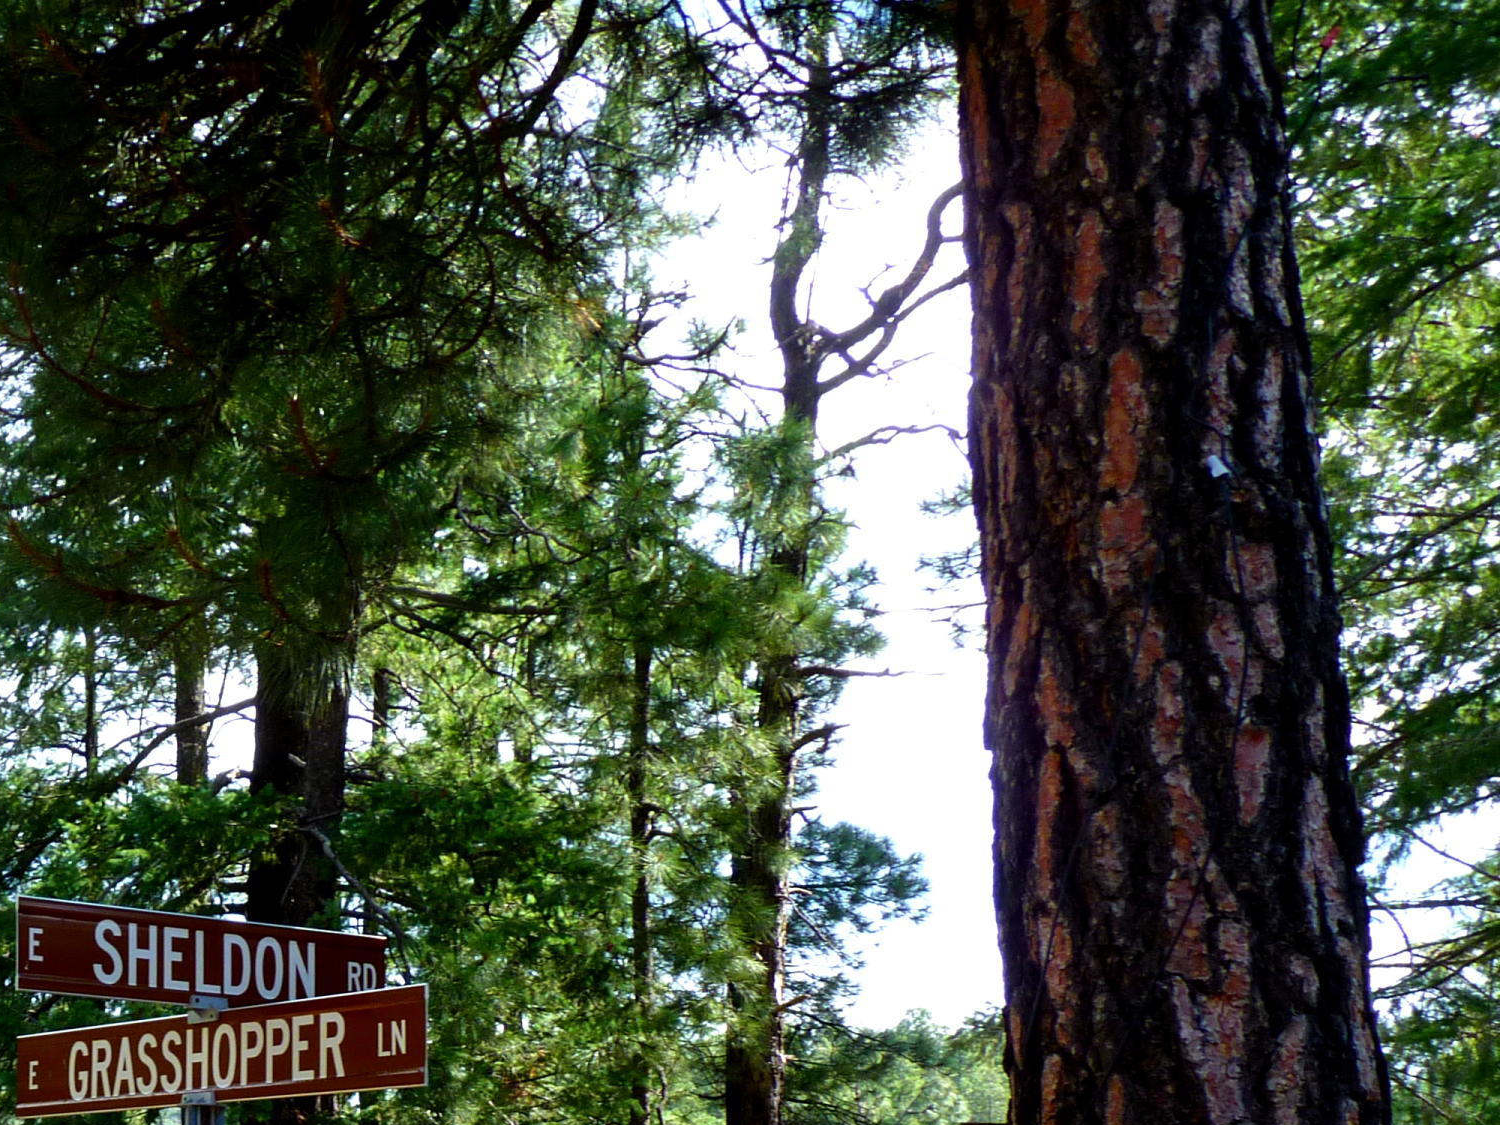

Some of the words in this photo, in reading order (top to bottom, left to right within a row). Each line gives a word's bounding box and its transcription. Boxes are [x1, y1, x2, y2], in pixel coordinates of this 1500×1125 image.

[28, 927, 44, 962] E
[92, 918, 316, 1000] SHELDON
[347, 961, 377, 994] RD
[28, 1060, 39, 1091] E
[68, 1011, 346, 1101] GRASSHOPPER
[377, 1019, 407, 1058] LN
